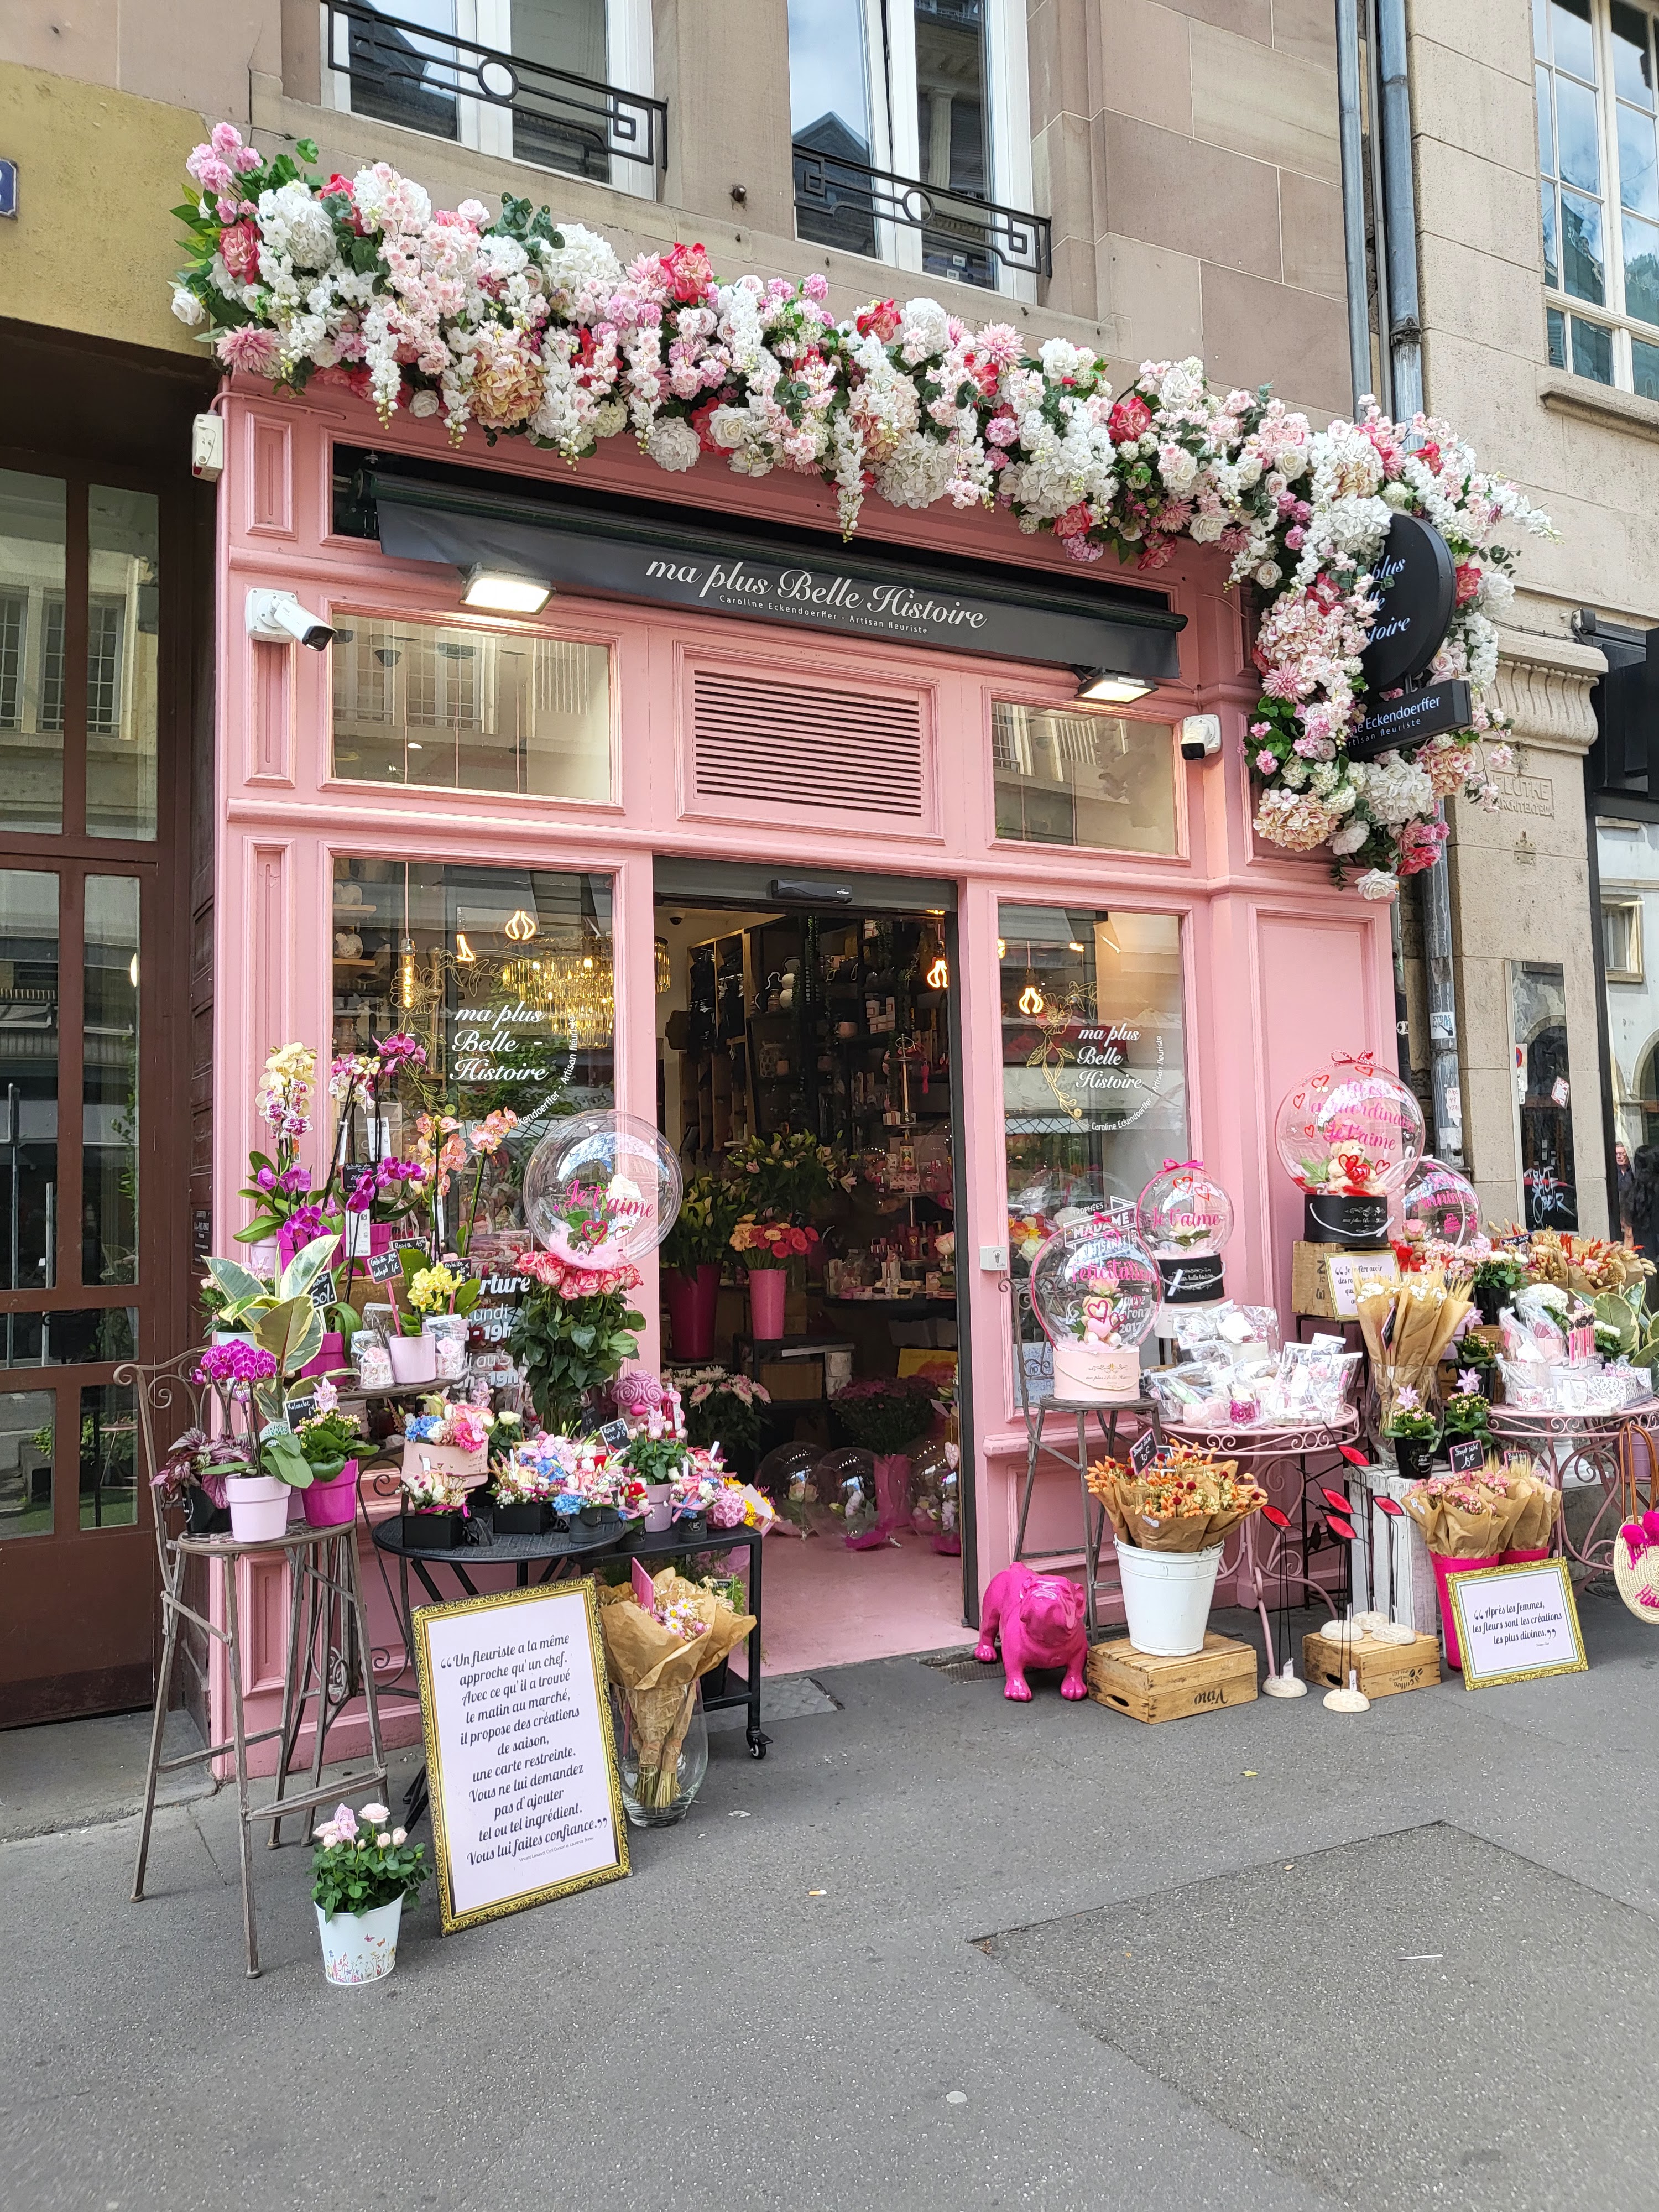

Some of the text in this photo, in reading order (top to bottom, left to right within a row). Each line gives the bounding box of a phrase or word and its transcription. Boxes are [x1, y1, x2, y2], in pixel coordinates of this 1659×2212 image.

[645, 560, 989, 629] ma plus Belle Histoire
[719, 594, 764, 609] Caroline
[768, 602, 838, 621] Eckendoerffer
[849, 614, 885, 629] Artisan
[887, 620, 928, 635] fleuriste
[1365, 696, 1441, 730] Eckendoerffer
[1348, 733, 1376, 748] rtisan
[1380, 718, 1422, 737] fleuriste
[453, 1000, 547, 1030] ma plus
[451, 1029, 520, 1052] Belle
[567, 1016, 578, 1051] fleuriste
[1078, 1022, 1141, 1047] ma plus
[1077, 1045, 1124, 1065] Belle
[1155, 1035, 1164, 1066] fleuriste
[449, 1057, 550, 1081] Histoire
[560, 1053, 577, 1085] Artisan
[1075, 1069, 1144, 1089] Histoire
[1151, 1066, 1164, 1092] Artisan
[1091, 1121, 1118, 1131] Caroline
[1117, 1097, 1152, 1129] Eckendoerffer
[1073, 1202, 1104, 1217] TROPHÉES
[1472, 1611, 1563, 1635] les fleurs sont les créations
[1506, 1603, 1517, 1615] les
[1516, 1600, 1546, 1616] femmes,
[471, 1645, 515, 1668] fleuriste
[518, 1644, 525, 1654] a
[526, 1640, 538, 1652] la
[539, 1634, 570, 1650] même
[1493, 1634, 1504, 1645] les
[1504, 1632, 1519, 1647] plus
[459, 1665, 509, 1688] approche
[544, 1651, 568, 1668] chef.
[461, 1690, 488, 1707] Avec
[489, 1687, 501, 1699] ce
[529, 1679, 537, 1690] a
[538, 1667, 571, 1688] trouvé
[1194, 1688, 1228, 1705] Vino
[466, 1687, 571, 1724] le matin au marché,
[460, 1707, 580, 1747] il propose des créations
[497, 1735, 550, 1756] de saison,
[472, 1746, 577, 1783] une carte restreinte.
[468, 1764, 585, 1803] Vous ne lui demandez
[478, 1802, 583, 1843] tel ou tel ingrédient.
[493, 1802, 514, 1822] pas
[466, 1849, 495, 1866] Vous
[497, 1840, 512, 1858] lui
[511, 1834, 544, 1858] faites
